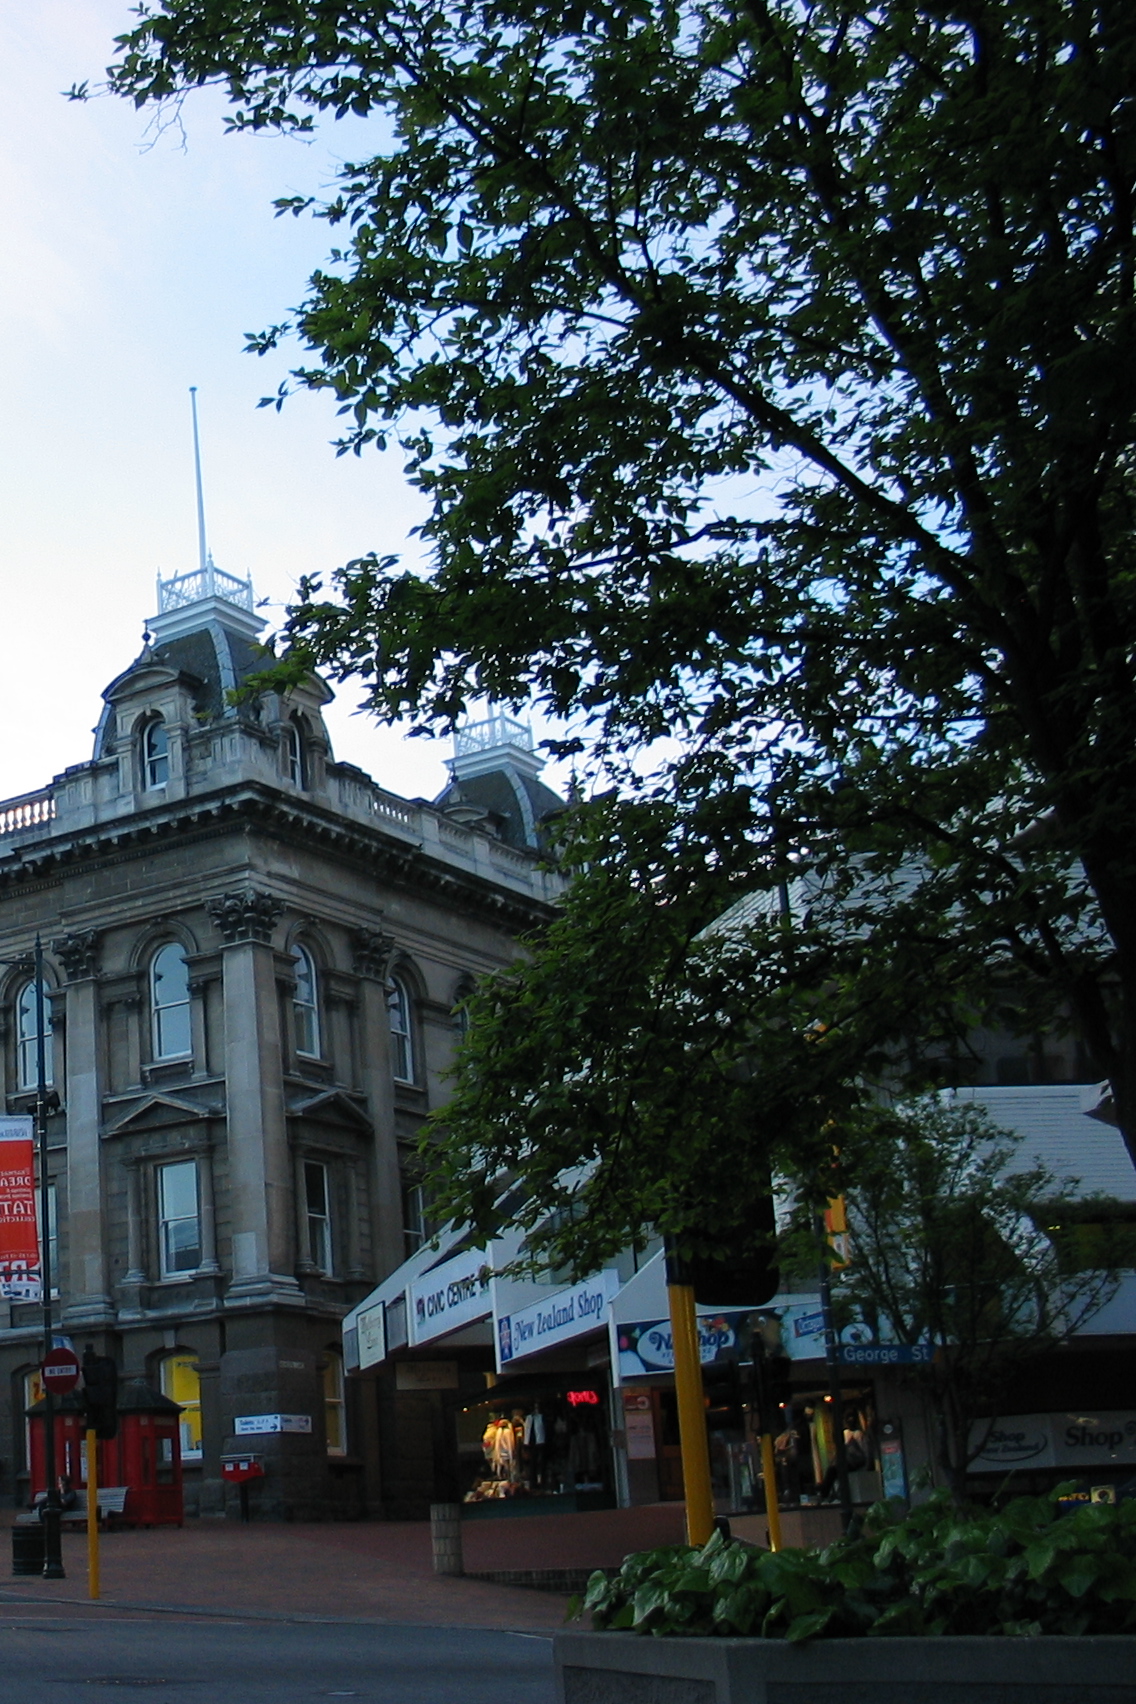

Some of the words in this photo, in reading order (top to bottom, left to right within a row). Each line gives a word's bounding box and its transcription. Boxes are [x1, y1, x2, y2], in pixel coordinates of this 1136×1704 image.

[427, 1289, 445, 1317] CIVIC
[514, 1319, 535, 1351] New
[537, 1297, 574, 1335] Zealand
[578, 1290, 603, 1320] Shop
[844, 1346, 898, 1364] George
[911, 1346, 928, 1361] St
[988, 1430, 1025, 1445] Shop
[1065, 1426, 1123, 1450] Shop
